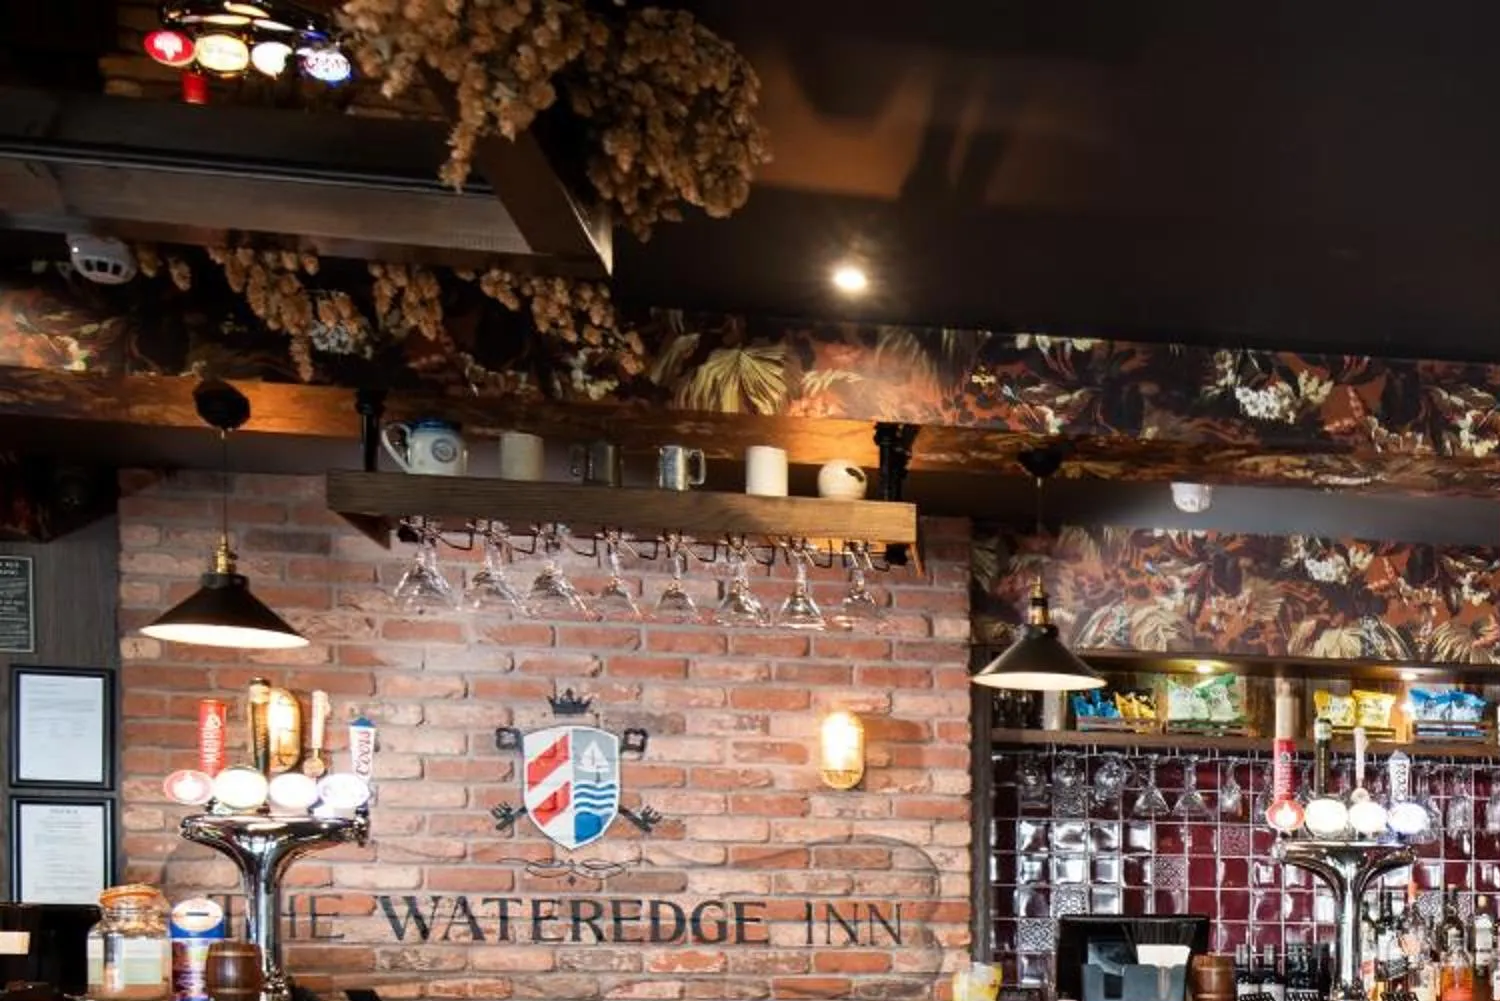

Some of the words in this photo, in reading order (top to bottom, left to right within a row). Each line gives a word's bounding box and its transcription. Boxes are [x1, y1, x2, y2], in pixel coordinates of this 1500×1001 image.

[356, 730, 373, 780] Coors
[373, 895, 769, 945] WATEREDGE
[804, 900, 904, 946] INN
